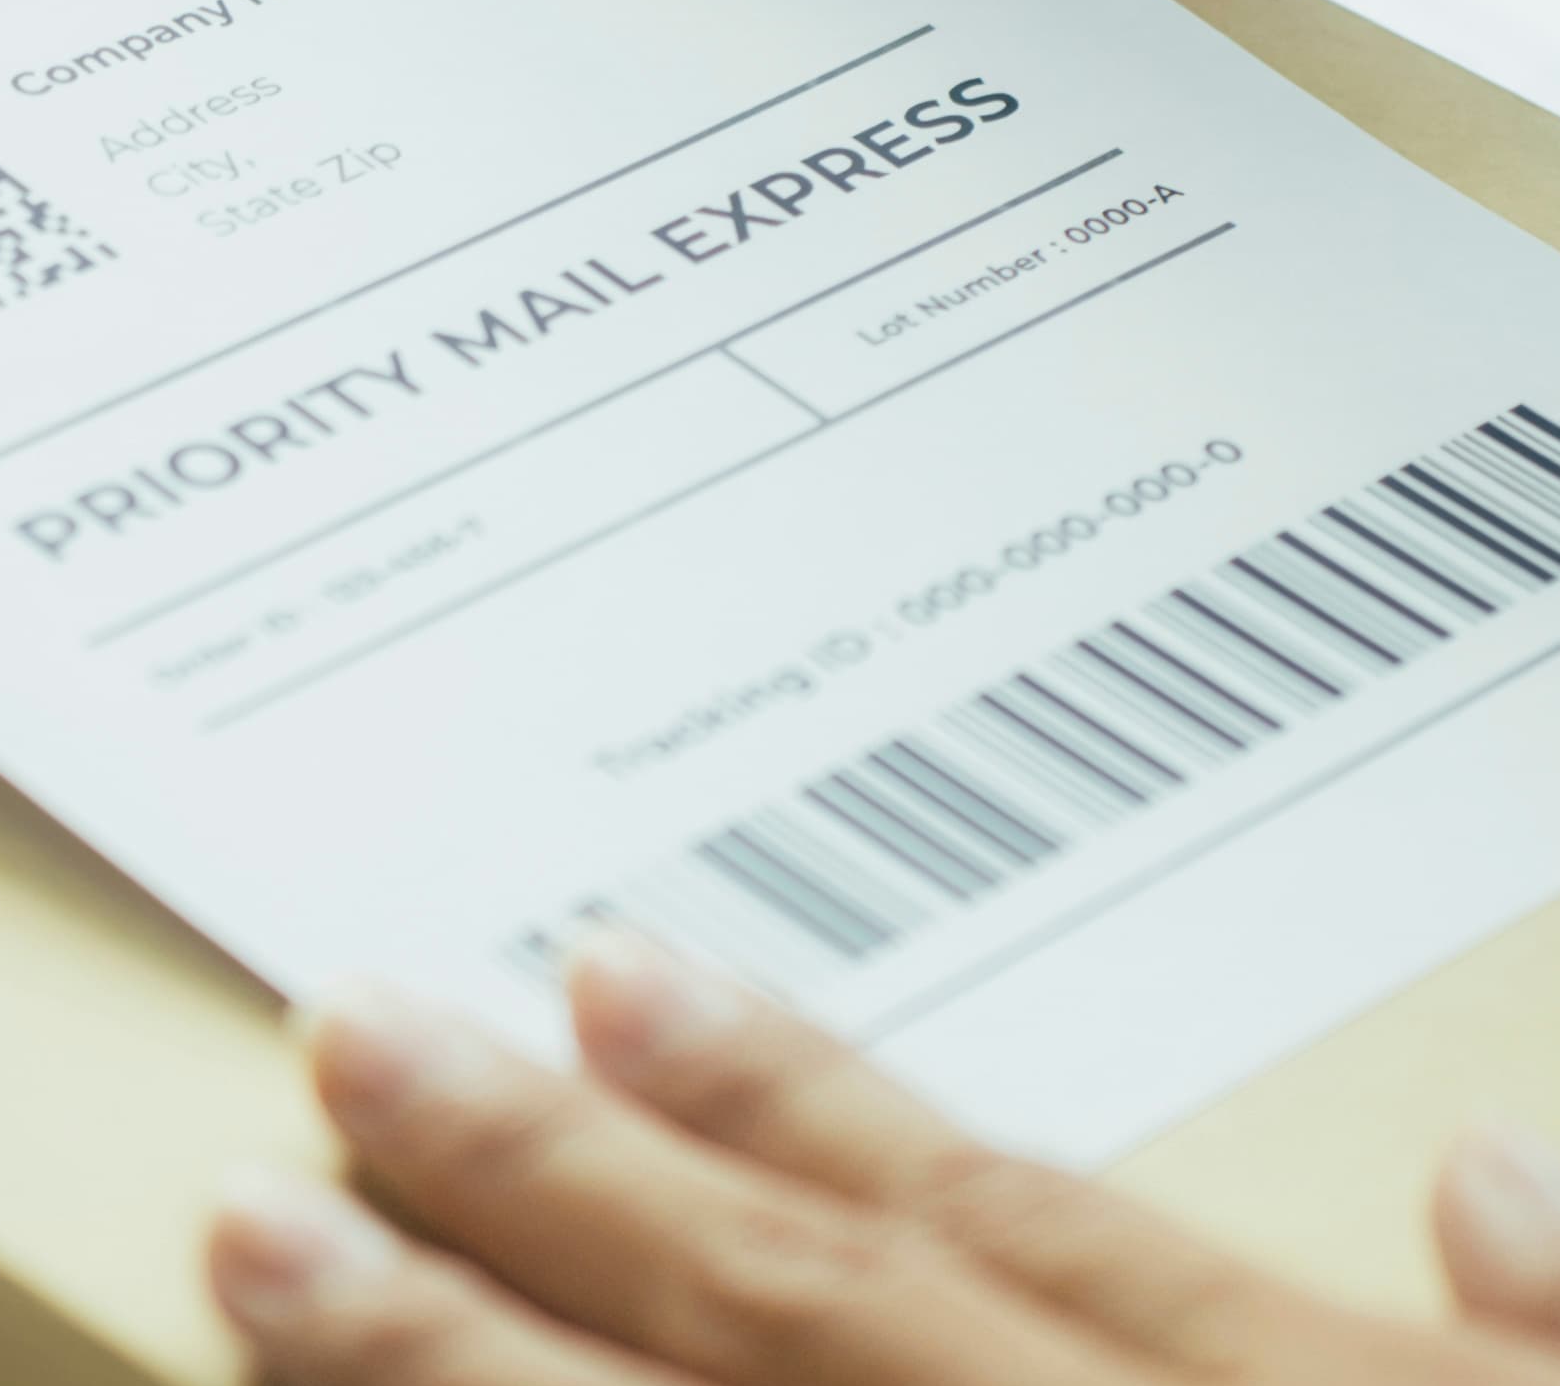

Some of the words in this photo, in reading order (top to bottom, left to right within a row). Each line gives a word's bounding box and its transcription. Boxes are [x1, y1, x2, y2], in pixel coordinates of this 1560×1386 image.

[98, 75, 283, 164] Address
[195, 173, 325, 239] State
[316, 139, 403, 186] Zip
[14, 349, 422, 563] PRIORITY
[431, 258, 665, 368] MAIL
[650, 77, 1020, 265] EXPRESS
[856, 309, 918, 347] Lot
[914, 245, 1048, 318] Number
[1063, 183, 1186, 245] 0000-A
[897, 438, 1243, 627] 000-000-000-0
